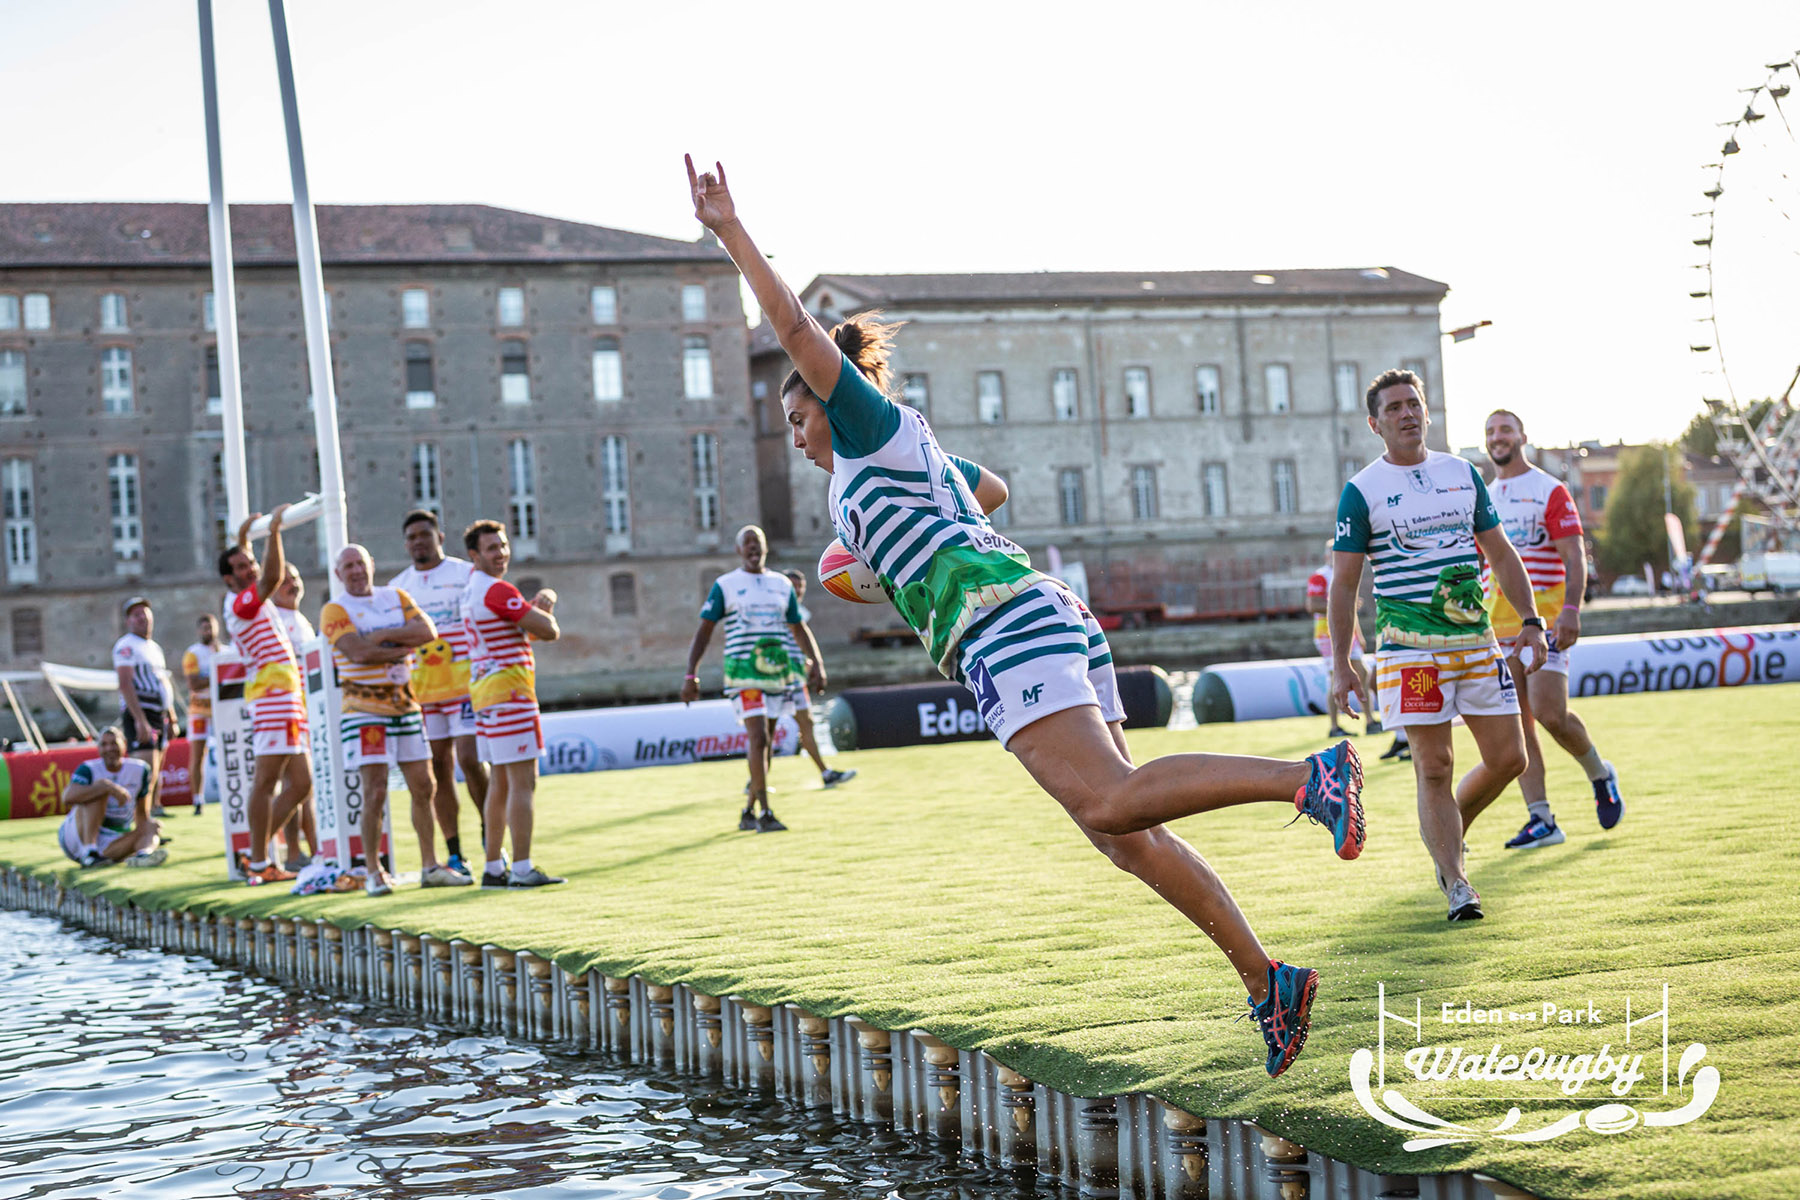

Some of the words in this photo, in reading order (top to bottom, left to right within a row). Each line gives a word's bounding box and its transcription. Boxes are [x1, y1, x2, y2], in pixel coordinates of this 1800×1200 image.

[1412, 515, 1432, 525] Eden
[1441, 510, 1460, 518] Park
[1022, 683, 1044, 704] MF
[222, 730, 244, 824] SOCIETE
[312, 729, 327, 829] SOCIETE
[318, 702, 335, 828] GENERALE
[549, 741, 587, 767] ifri
